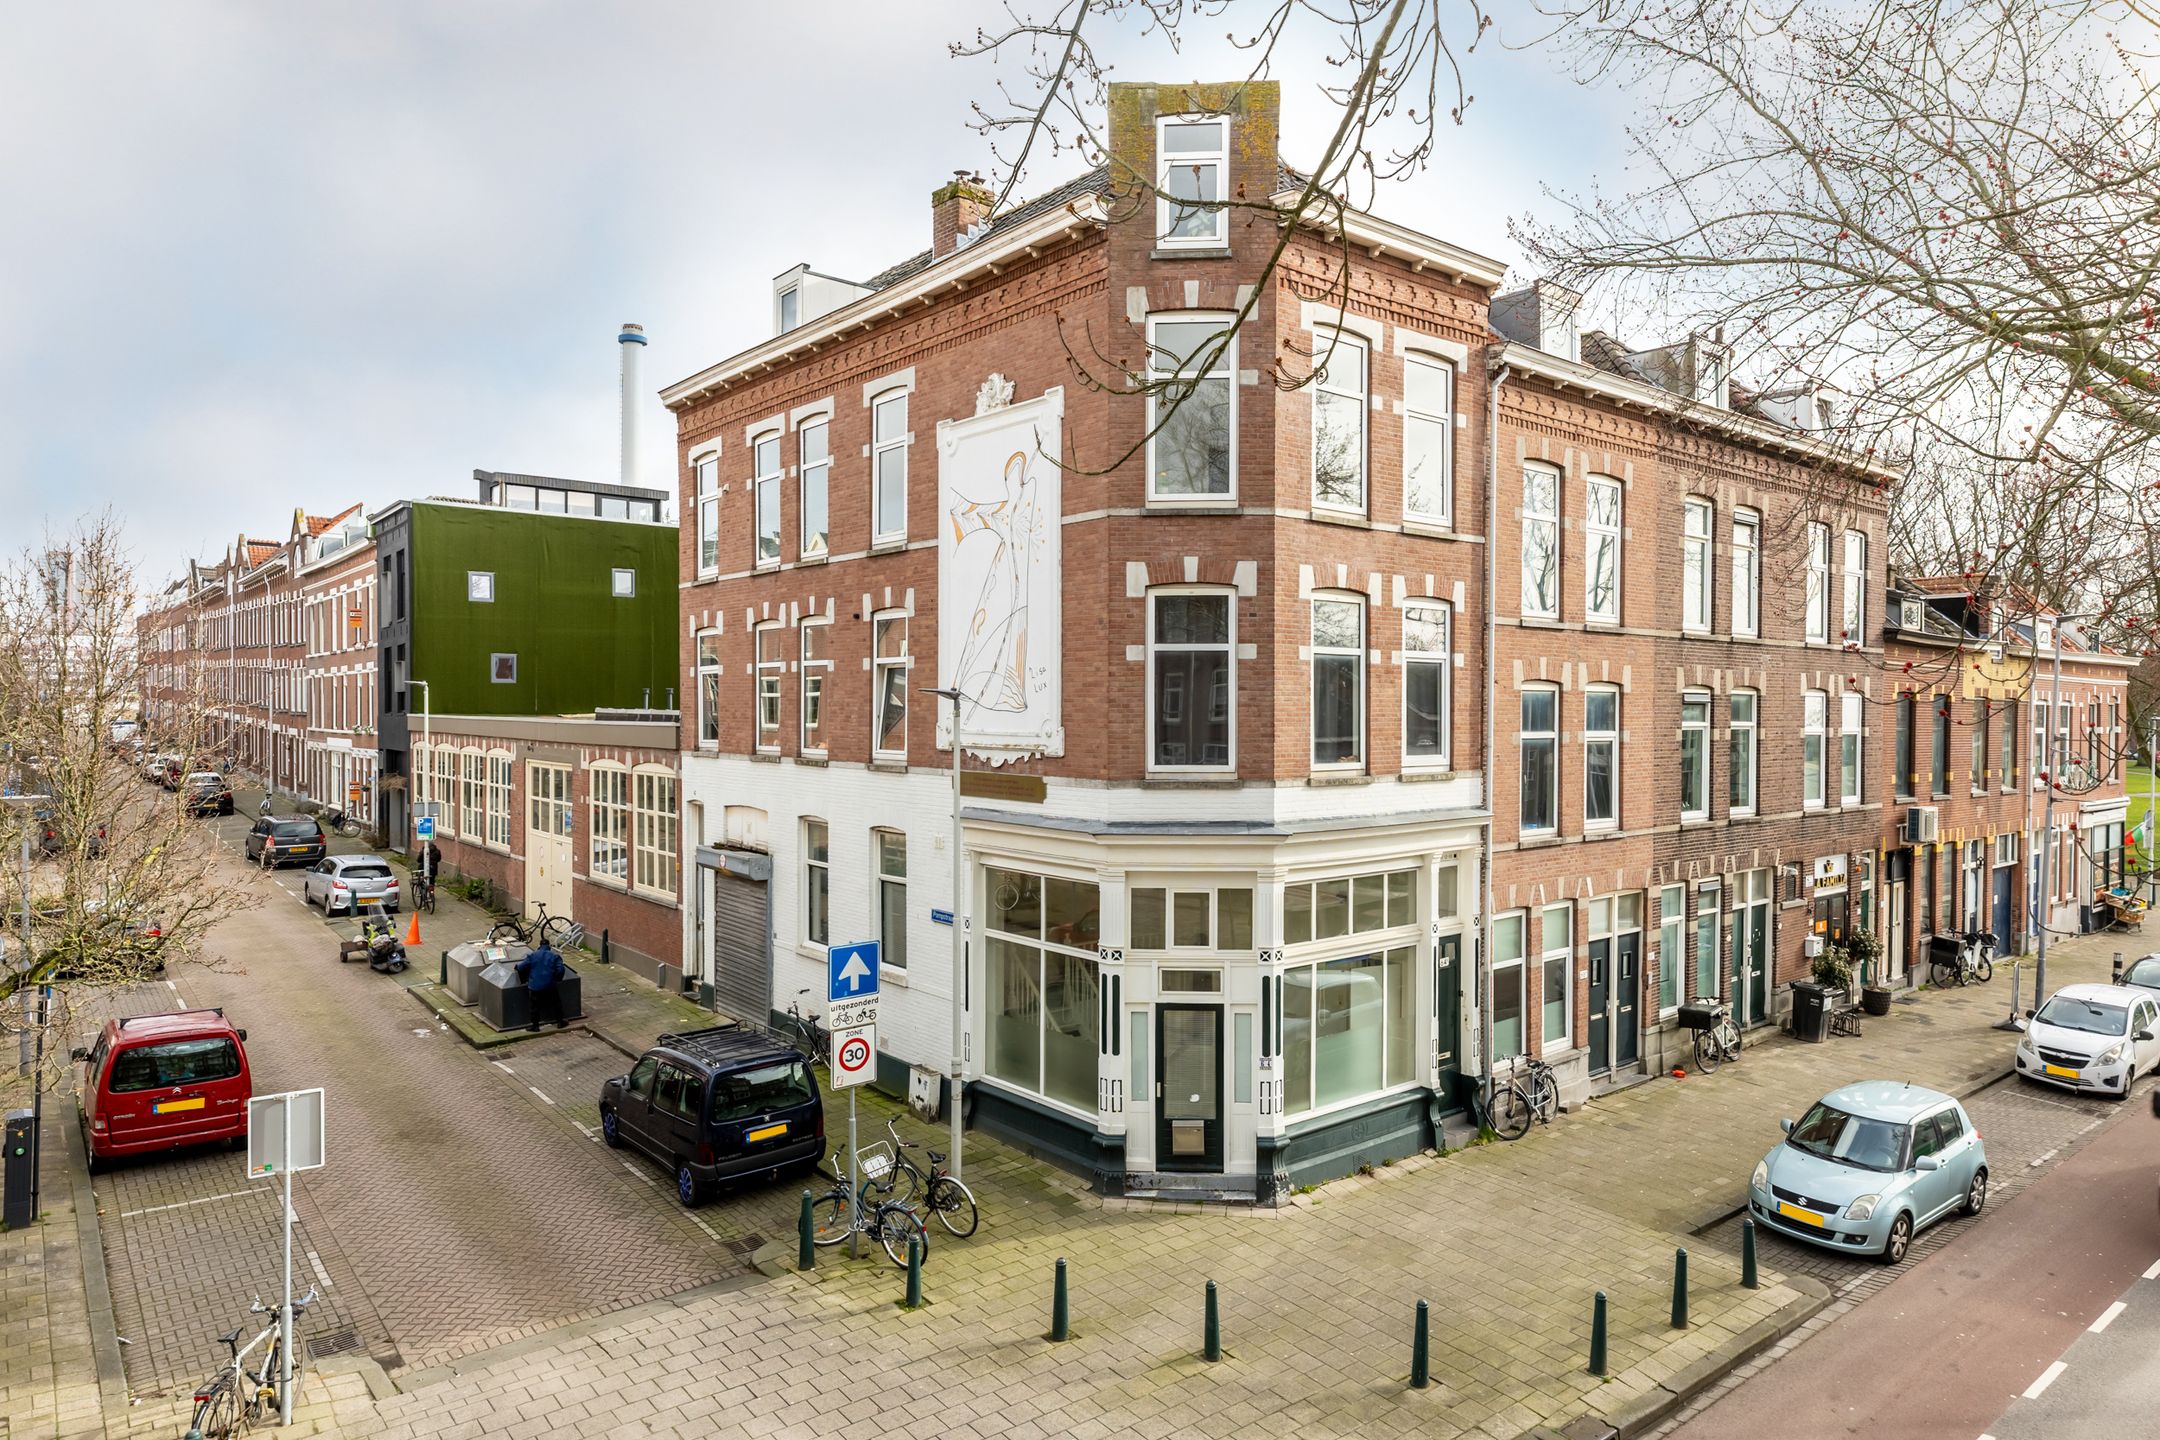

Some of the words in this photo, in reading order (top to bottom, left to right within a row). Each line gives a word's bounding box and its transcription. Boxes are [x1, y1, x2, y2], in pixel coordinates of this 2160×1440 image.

[830, 996, 879, 1012] uitgezonderd
[845, 1029, 864, 1038] ZONE
[845, 1047, 865, 1062] 30
